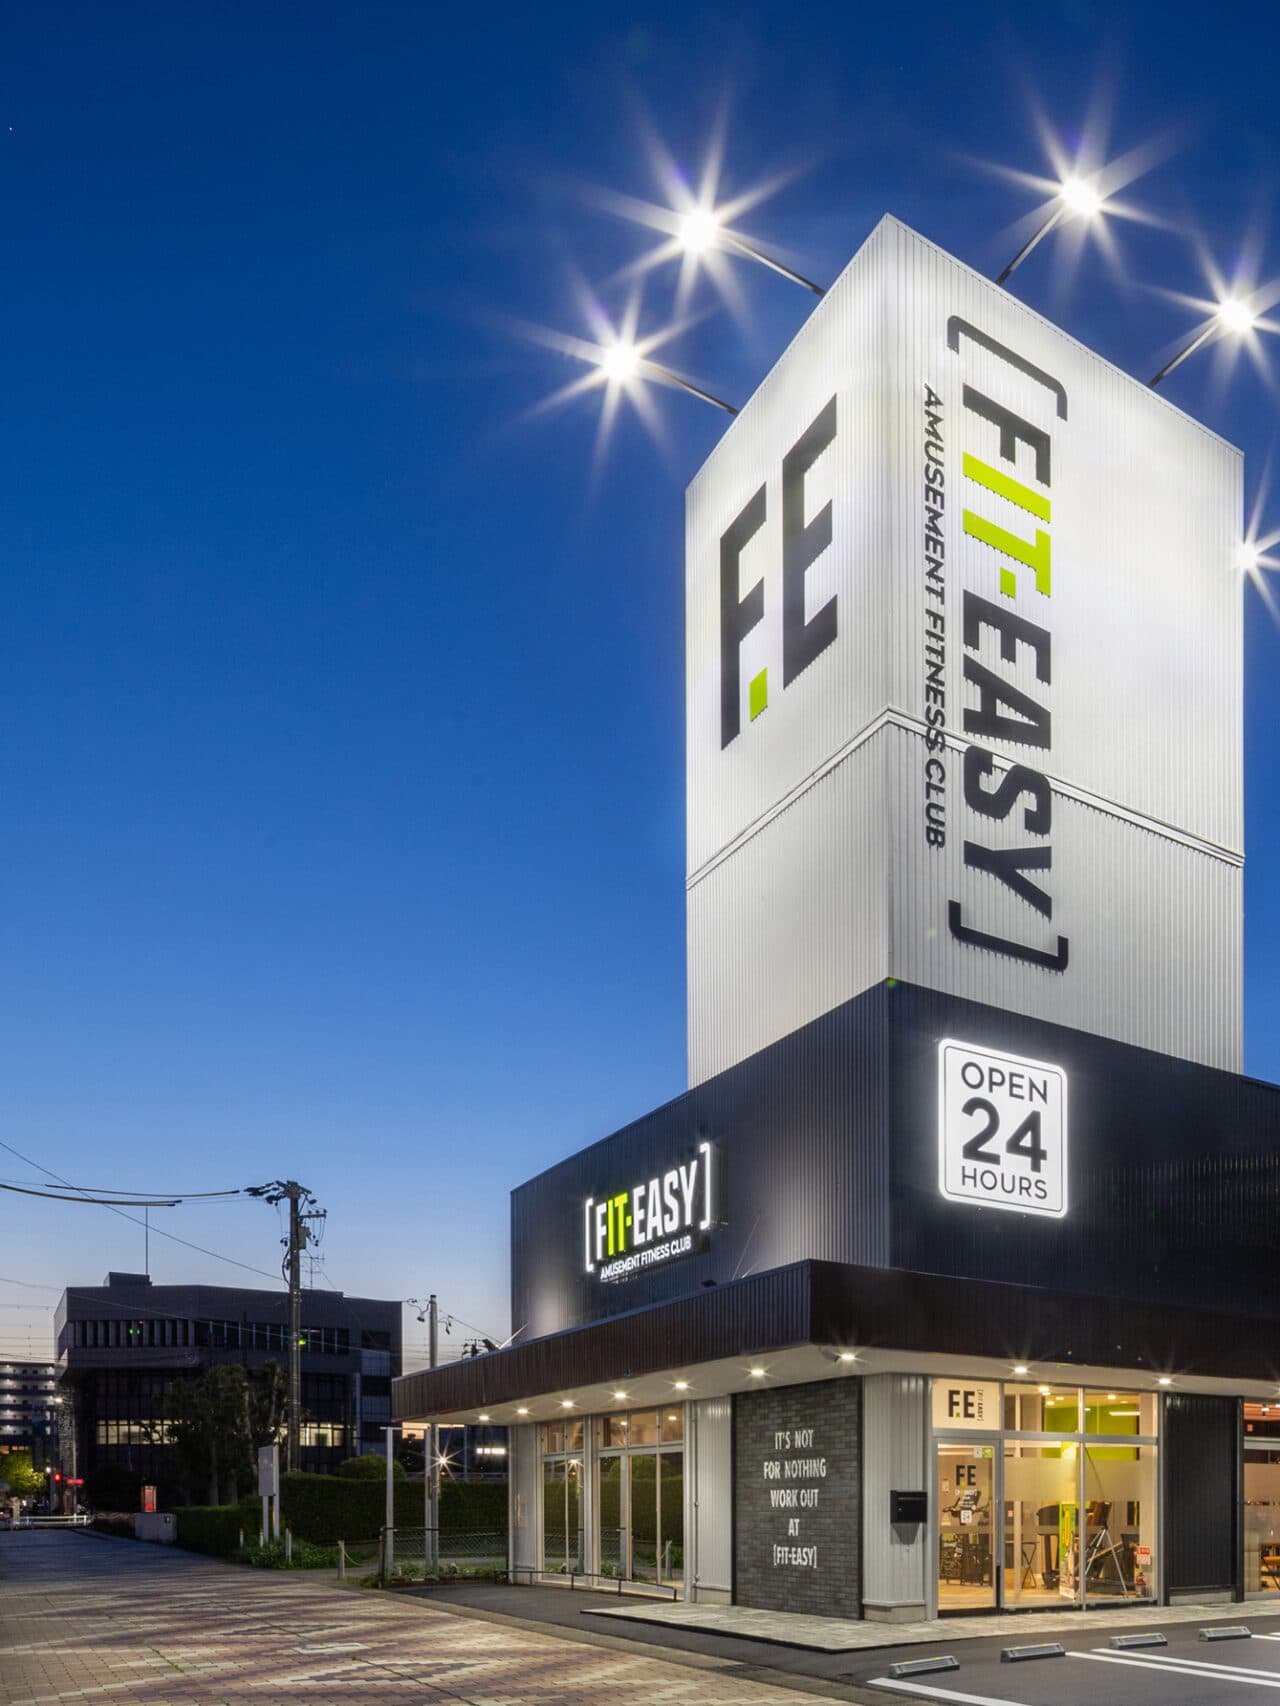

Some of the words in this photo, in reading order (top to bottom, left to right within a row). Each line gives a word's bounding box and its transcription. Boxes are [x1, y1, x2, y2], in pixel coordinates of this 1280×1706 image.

[924, 382, 945, 605] AMUSEMENT
[925, 608, 945, 753] FITNESS
[925, 758, 946, 849] CLUB
[961, 1061, 1048, 1104] OPEN
[961, 1097, 1047, 1173] 24
[961, 1165, 1048, 1200] HOURS
[600, 1253, 640, 1280] AMUSEMENT
[641, 1243, 670, 1266] FITNESS
[671, 1235, 691, 1255] CLUB
[775, 1431, 791, 1450] IT'S
[795, 1429, 814, 1448] NOT
[763, 1460, 781, 1479] FOR
[784, 1458, 827, 1479] NOTHING
[770, 1489, 798, 1508] WORK
[800, 1489, 819, 1508] OUT
[788, 1518, 800, 1537] AT
